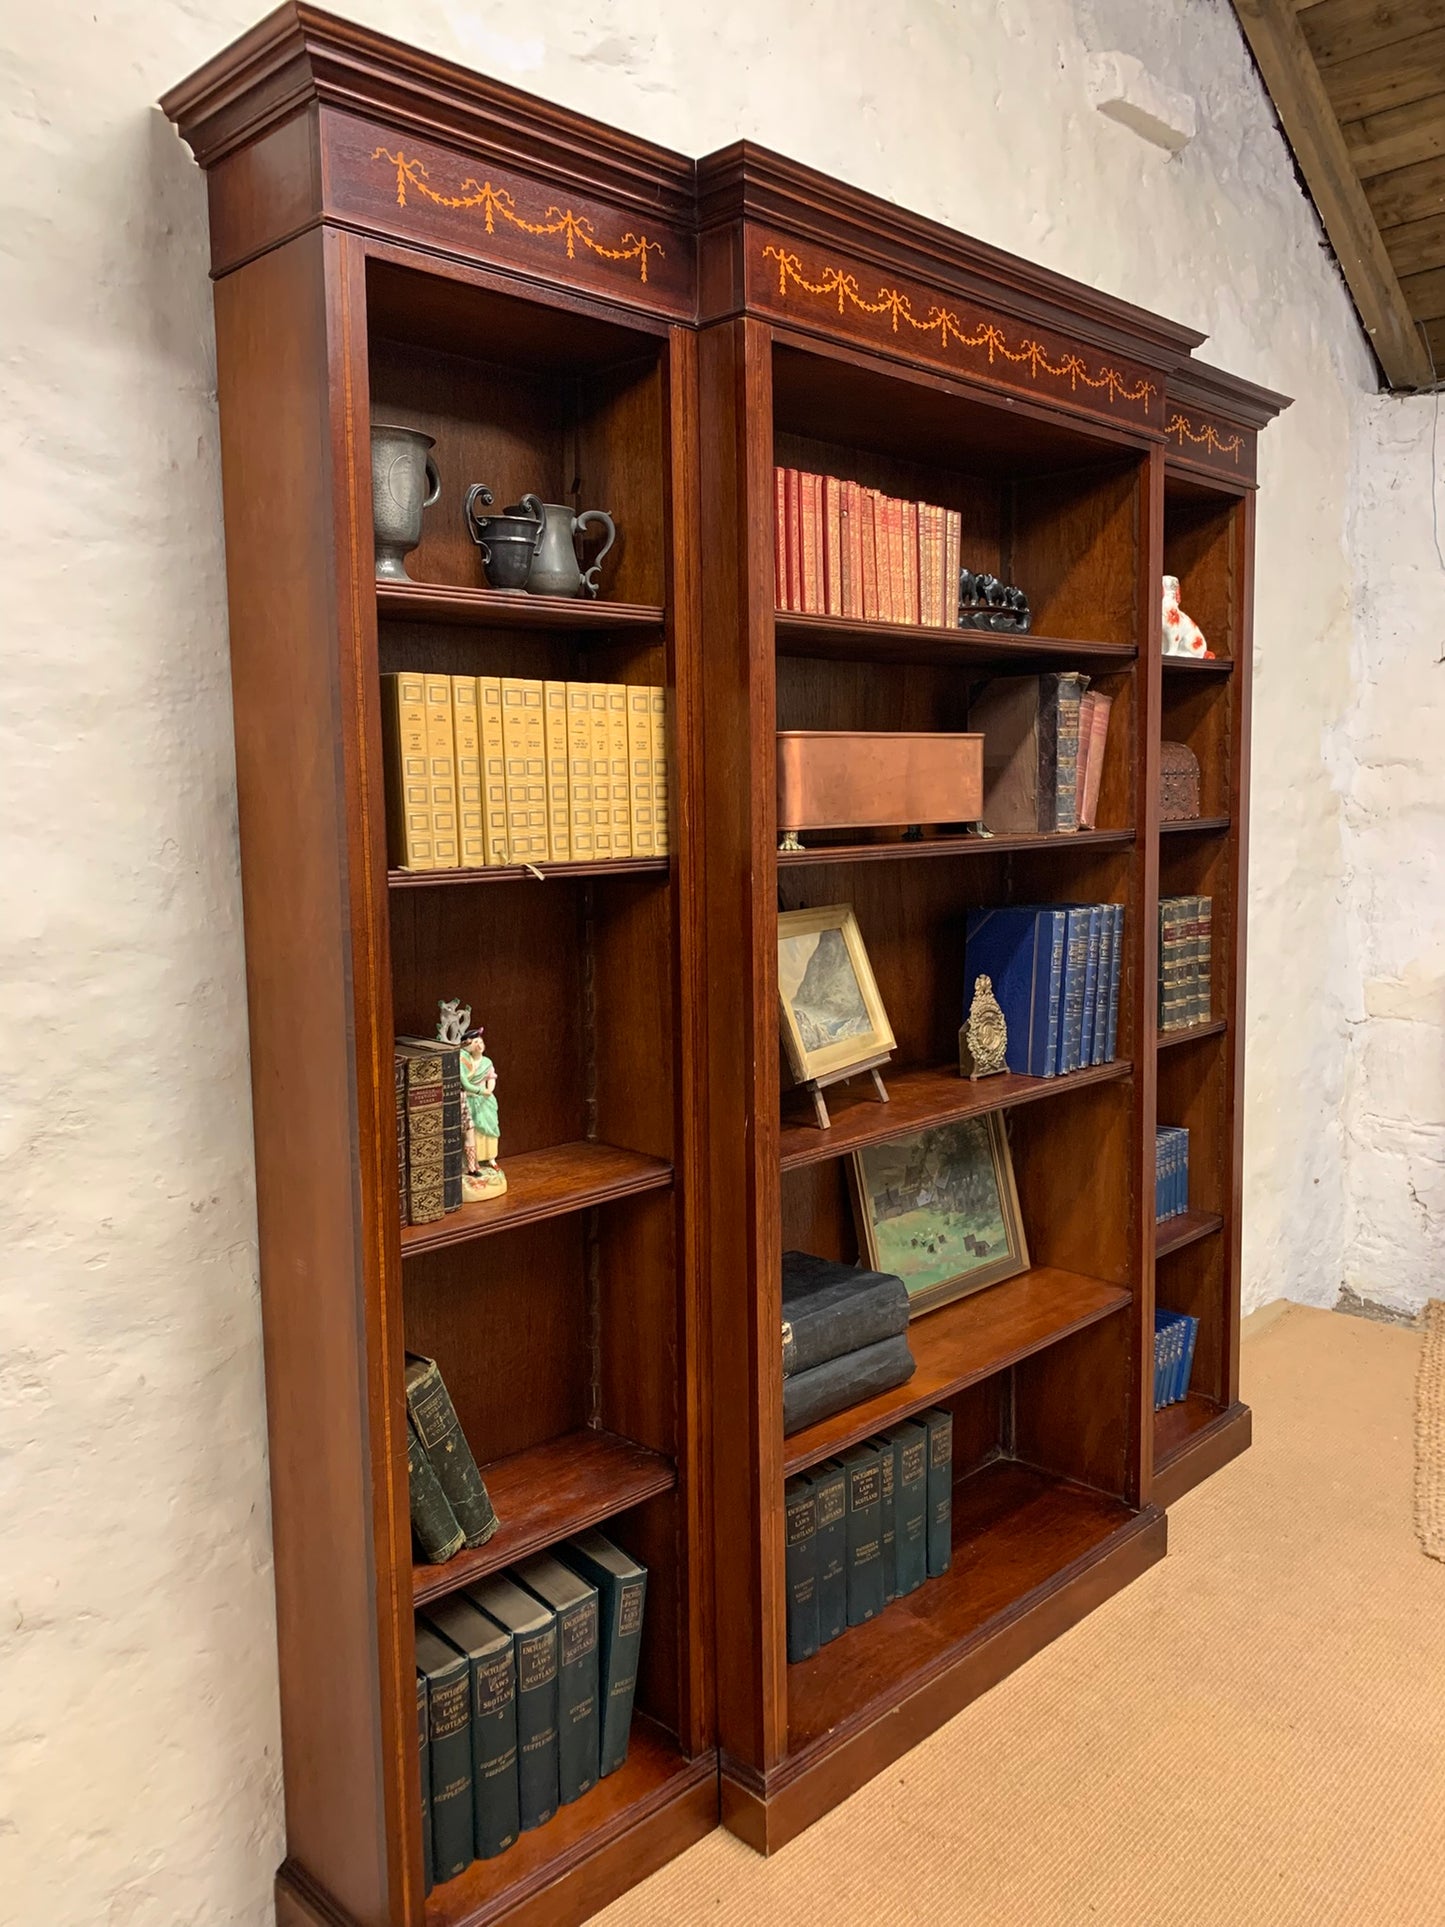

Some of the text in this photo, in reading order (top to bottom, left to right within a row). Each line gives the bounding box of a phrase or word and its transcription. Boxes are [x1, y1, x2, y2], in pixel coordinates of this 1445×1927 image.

[571, 1628, 588, 1642] LAWS
[532, 1655, 551, 1669] LAWS
[489, 1679, 509, 1692] LAWS
[443, 1702, 464, 1717] LAWS
[435, 1713, 468, 1734] SCOTLAND
